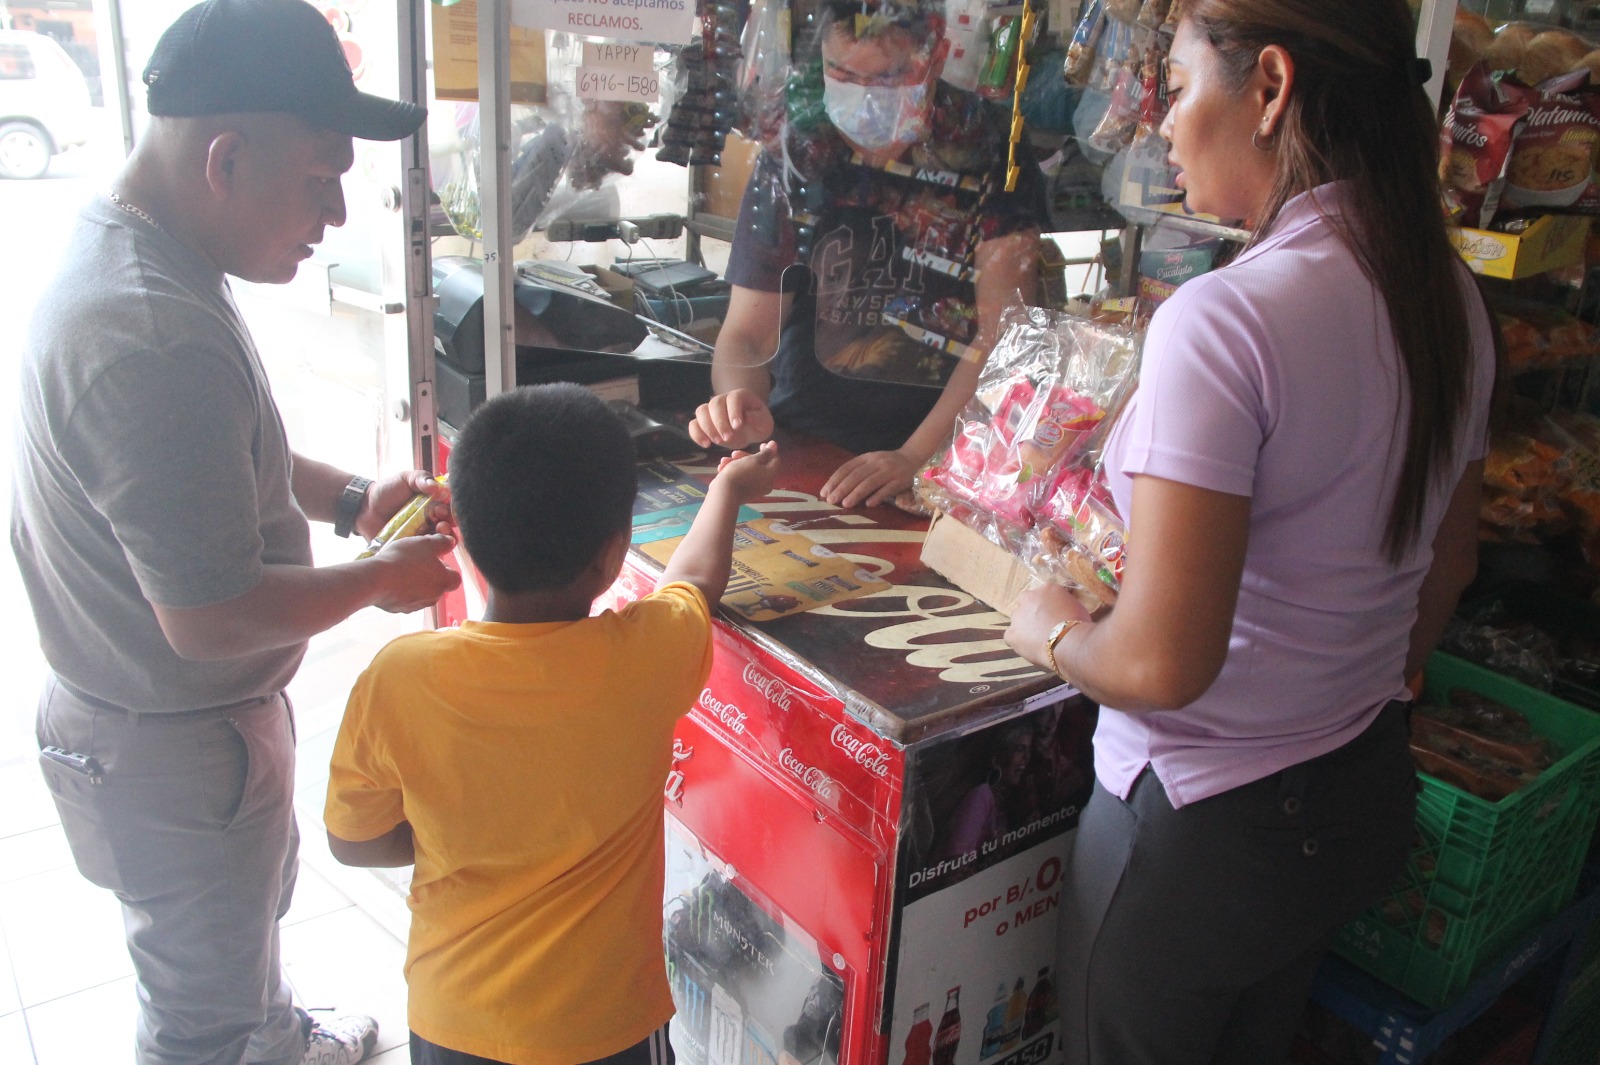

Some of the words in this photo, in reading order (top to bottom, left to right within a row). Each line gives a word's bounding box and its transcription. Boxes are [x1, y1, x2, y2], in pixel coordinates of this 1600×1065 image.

[568, 12, 643, 31] RECLAMOS.
[595, 44, 640, 63] YAPPY
[580, 72, 658, 96] 6996-1580
[1157, 265, 1193, 280] Eucalipto
[699, 687, 748, 735] Coca-Cola
[742, 662, 793, 712] Coca-Cola
[779, 747, 833, 799] Coca-Cola
[830, 723, 892, 778] Coca-Cola
[908, 849, 978, 889] Disfruta
[982, 836, 998, 855] tu
[1002, 804, 1078, 845] momento.
[963, 895, 1002, 928] por
[713, 910, 775, 976] MONSTER
